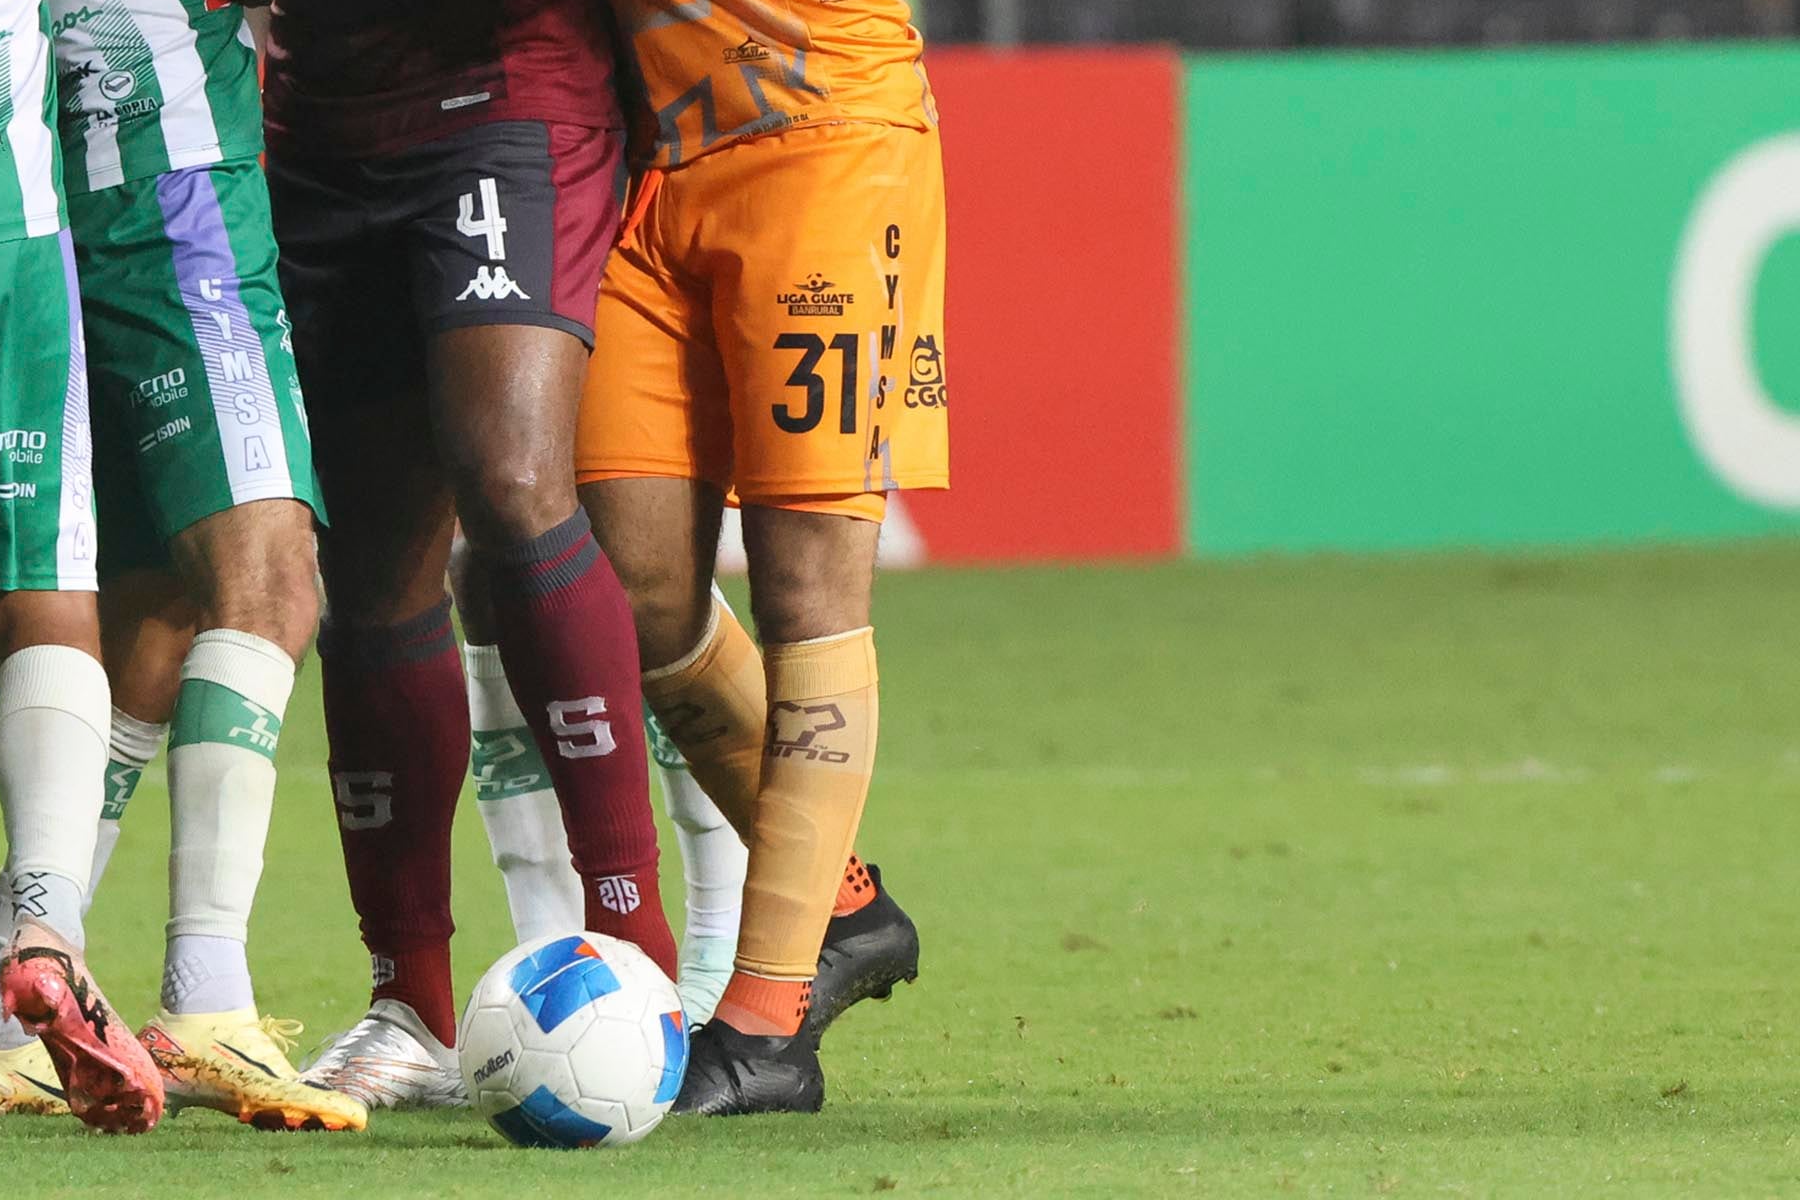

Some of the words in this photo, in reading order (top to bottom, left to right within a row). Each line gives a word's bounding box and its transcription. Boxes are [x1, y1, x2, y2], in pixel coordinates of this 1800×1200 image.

[457, 178, 507, 259] 4
[777, 294, 808, 304] LIGA
[811, 294, 855, 304] GUATE
[792, 305, 840, 315] BANRURAL
[870, 224, 900, 460] CYMSA
[772, 333, 858, 434] 31
[157, 416, 191, 442] ISDIN
[547, 696, 618, 760] S
[473, 1048, 515, 1085] molten
